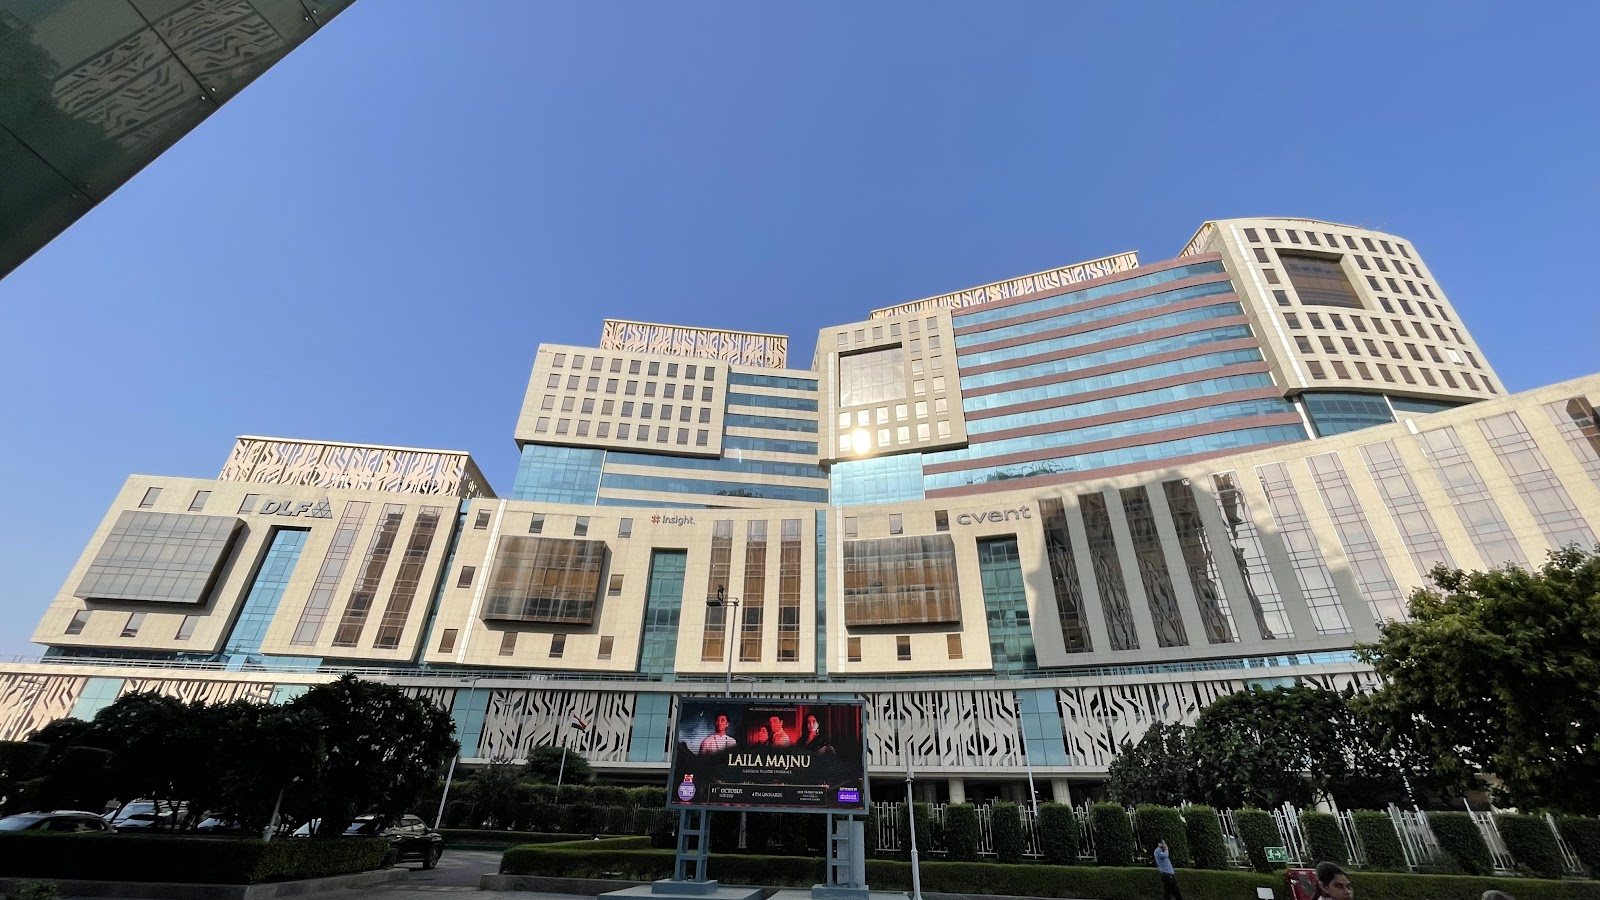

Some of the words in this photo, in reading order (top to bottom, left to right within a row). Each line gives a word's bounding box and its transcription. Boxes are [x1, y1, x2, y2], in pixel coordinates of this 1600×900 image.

[259, 499, 313, 516] DLF
[957, 505, 1031, 525] cvent
[728, 753, 763, 767] LAILA
[765, 754, 811, 770] MAJNU
